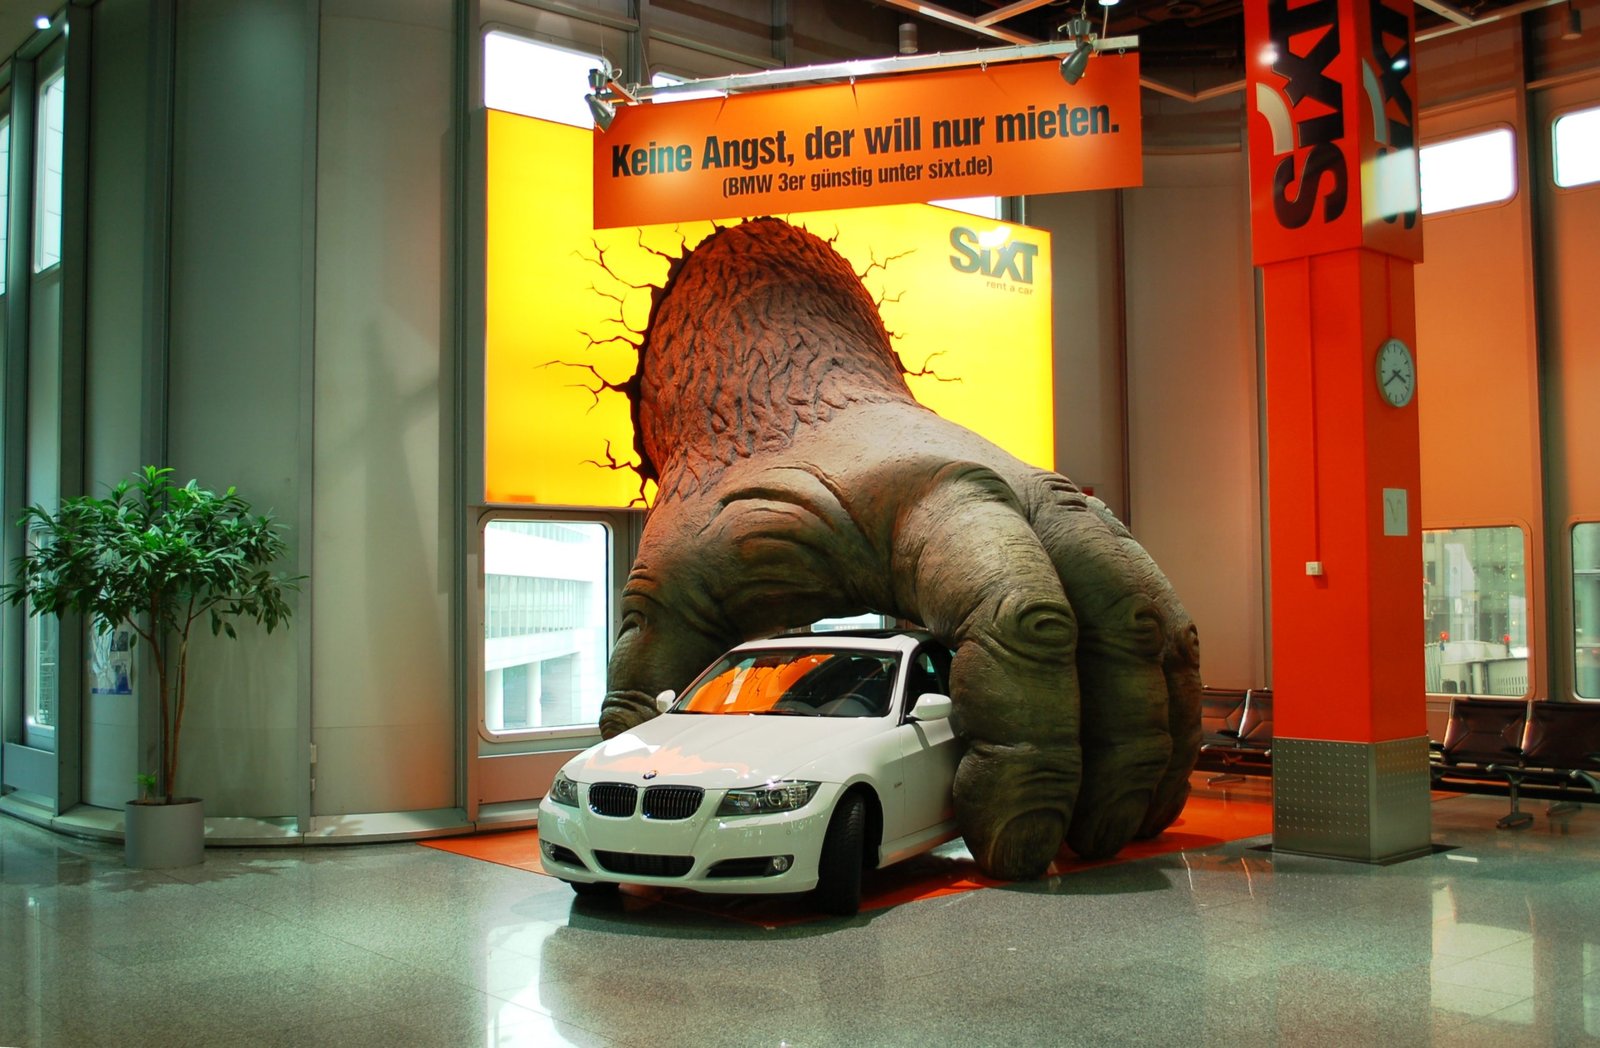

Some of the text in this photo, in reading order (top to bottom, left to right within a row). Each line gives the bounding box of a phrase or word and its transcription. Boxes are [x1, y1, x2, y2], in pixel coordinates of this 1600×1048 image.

[611, 103, 1120, 178] Keine Angst, der will nur mieten.
[722, 154, 993, 198] (BMW 3er günstig unter sixt.de)
[986, 280, 1007, 291] rent
[1018, 286, 1034, 296] car
